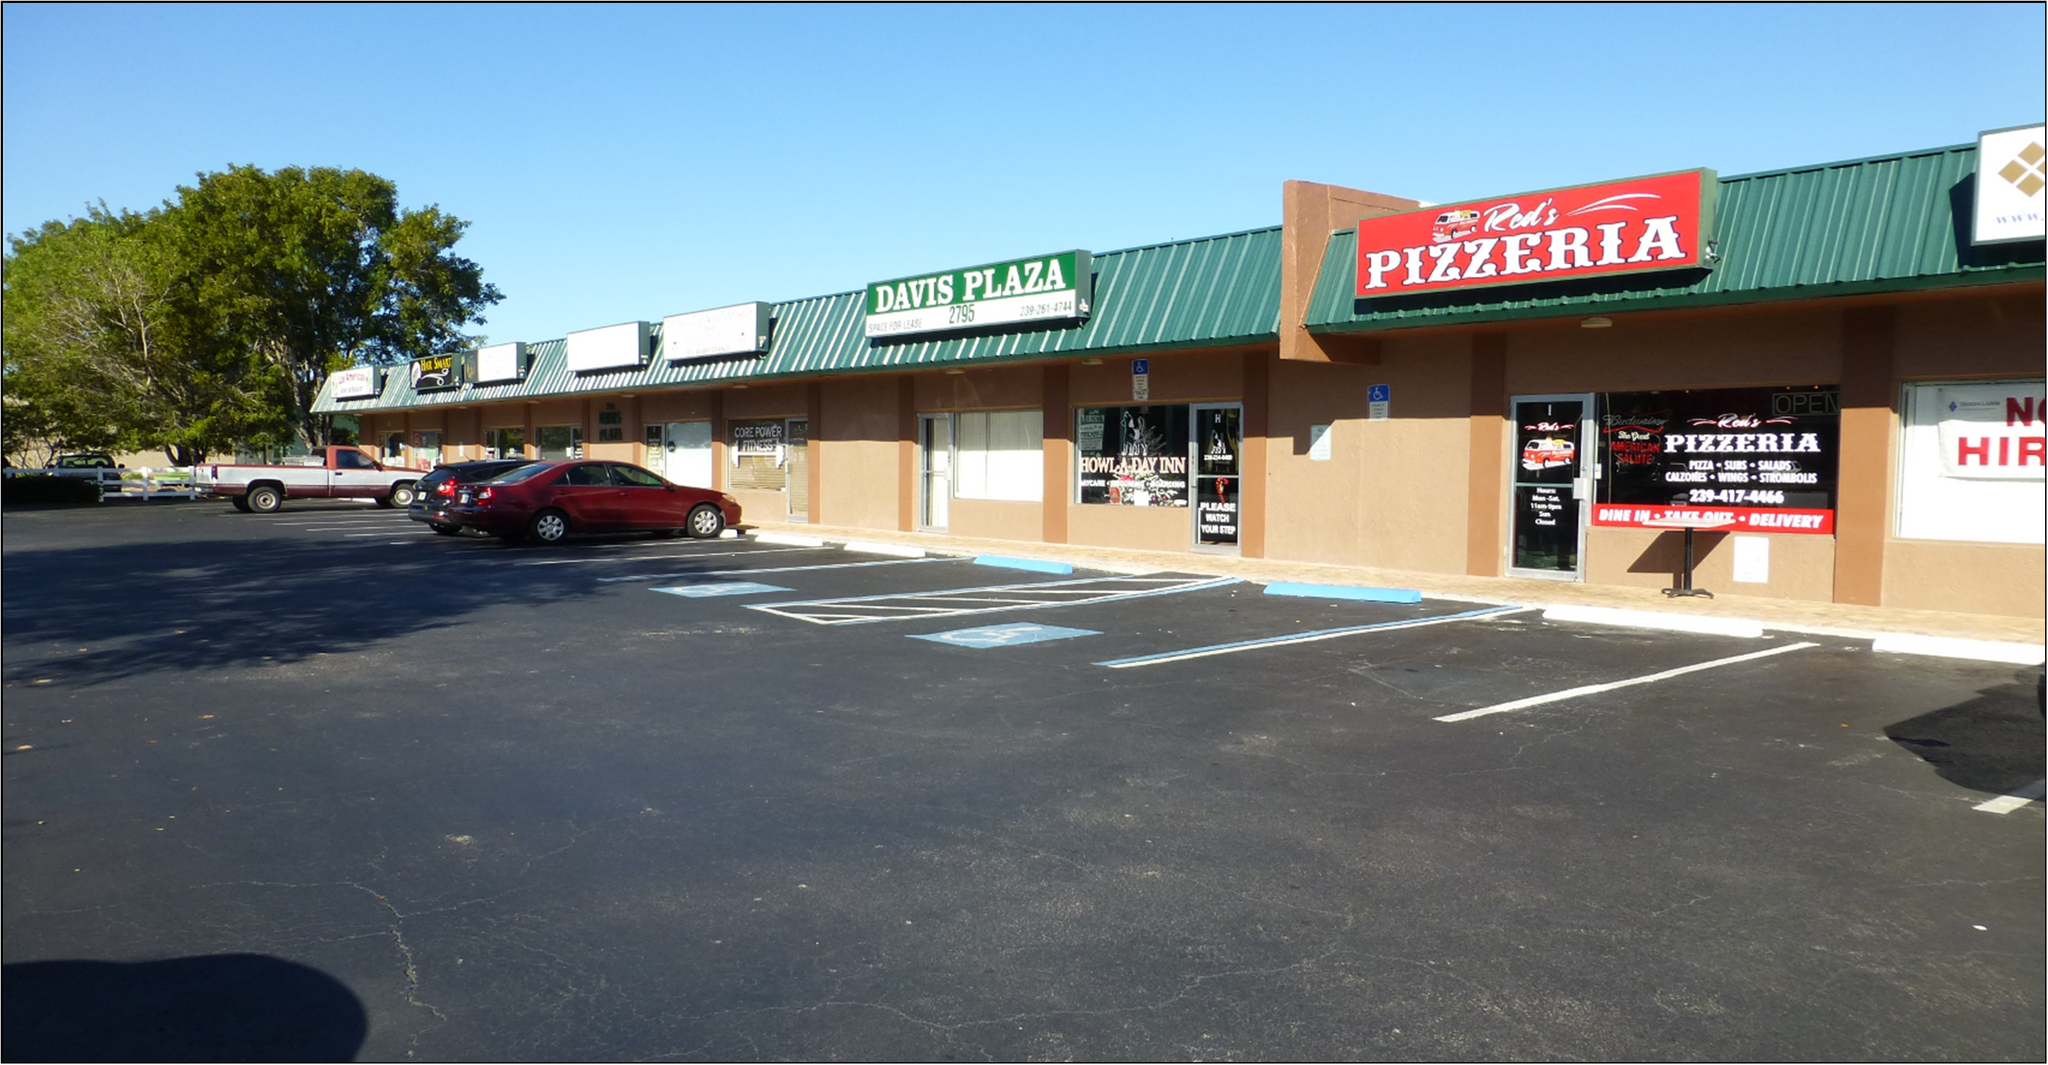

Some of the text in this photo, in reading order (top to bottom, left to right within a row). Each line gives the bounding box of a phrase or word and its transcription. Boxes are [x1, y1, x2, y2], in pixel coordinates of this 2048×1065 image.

[1483, 197, 1561, 233] Red's
[1364, 215, 1688, 290] PIZZERIA
[875, 258, 1066, 313] DAVIS PLAZA
[949, 304, 975, 324] 2795
[868, 318, 922, 334] SPACE FOR LEASE
[1776, 394, 1840, 414] OPEN
[2006, 396, 2045, 427] N
[735, 424, 782, 438] CORE POWER
[742, 440, 773, 452] FITNESS
[1610, 441, 1660, 453] AMERICAN
[1663, 433, 1821, 453] PIZZERIA
[1159, 456, 1186, 474] INN
[1617, 453, 1653, 464] SALUTE
[1689, 460, 1792, 471] PIZZA SUBS SALADS
[1665, 472, 1818, 483] CALZONES WINGS STROMBOLIS
[1689, 489, 1785, 504] 239-417-4466
[1200, 502, 1236, 512] PLEASE
[1205, 513, 1229, 523] WATCH
[1598, 509, 1631, 522] DINE
[1633, 510, 1651, 522] IN
[1749, 513, 1823, 529] DELIVERY
[1201, 524, 1236, 535] YOUR STEP
